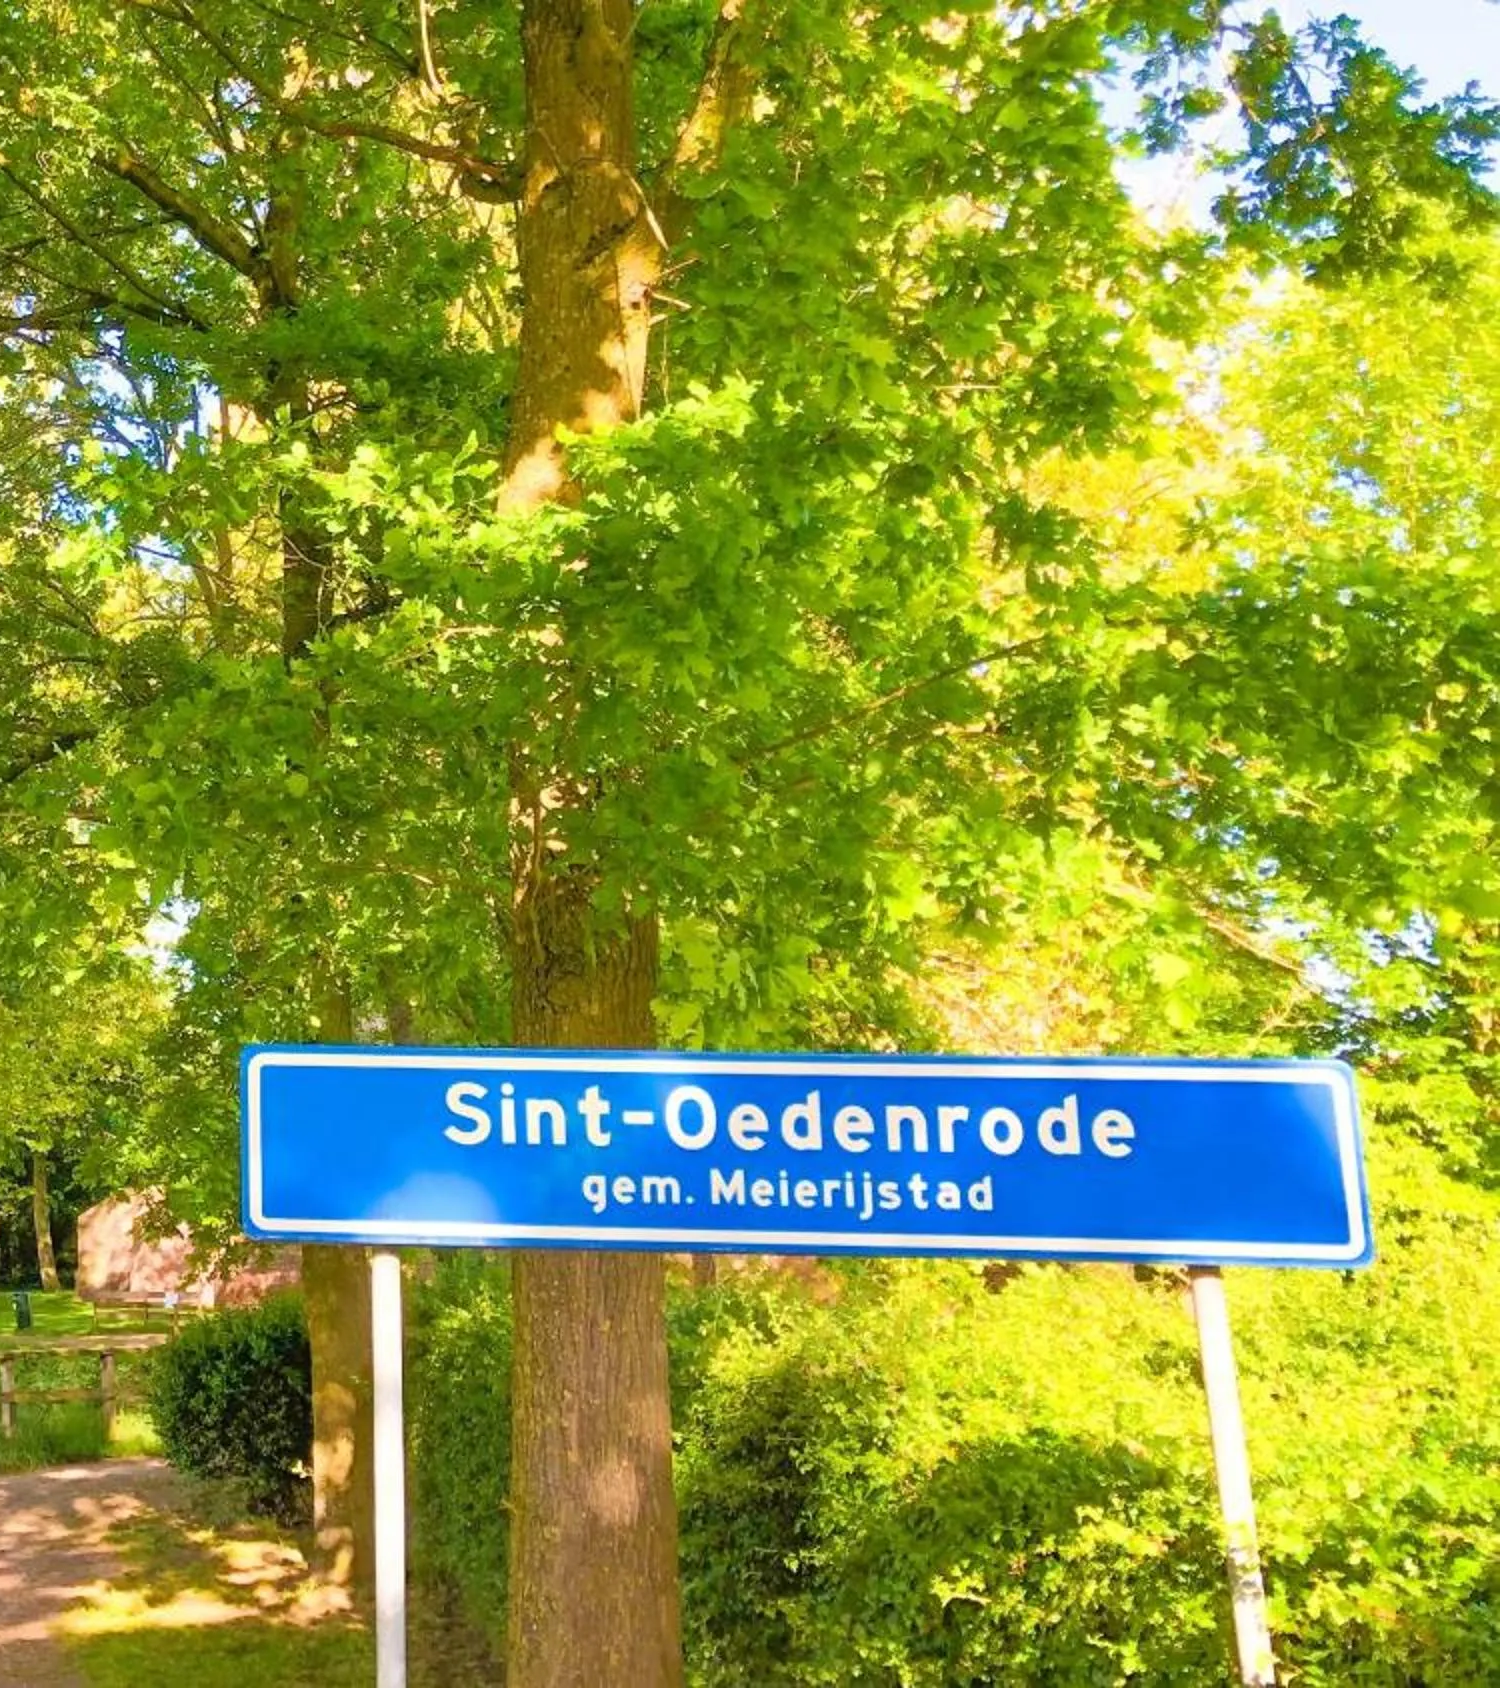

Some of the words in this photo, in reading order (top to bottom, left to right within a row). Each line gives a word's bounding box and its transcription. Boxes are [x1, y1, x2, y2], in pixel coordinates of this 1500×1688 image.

[443, 1081, 1136, 1159] Sint-Oedenrode
[581, 1174, 695, 1214] gem.
[709, 1168, 994, 1220] Meierijstad
